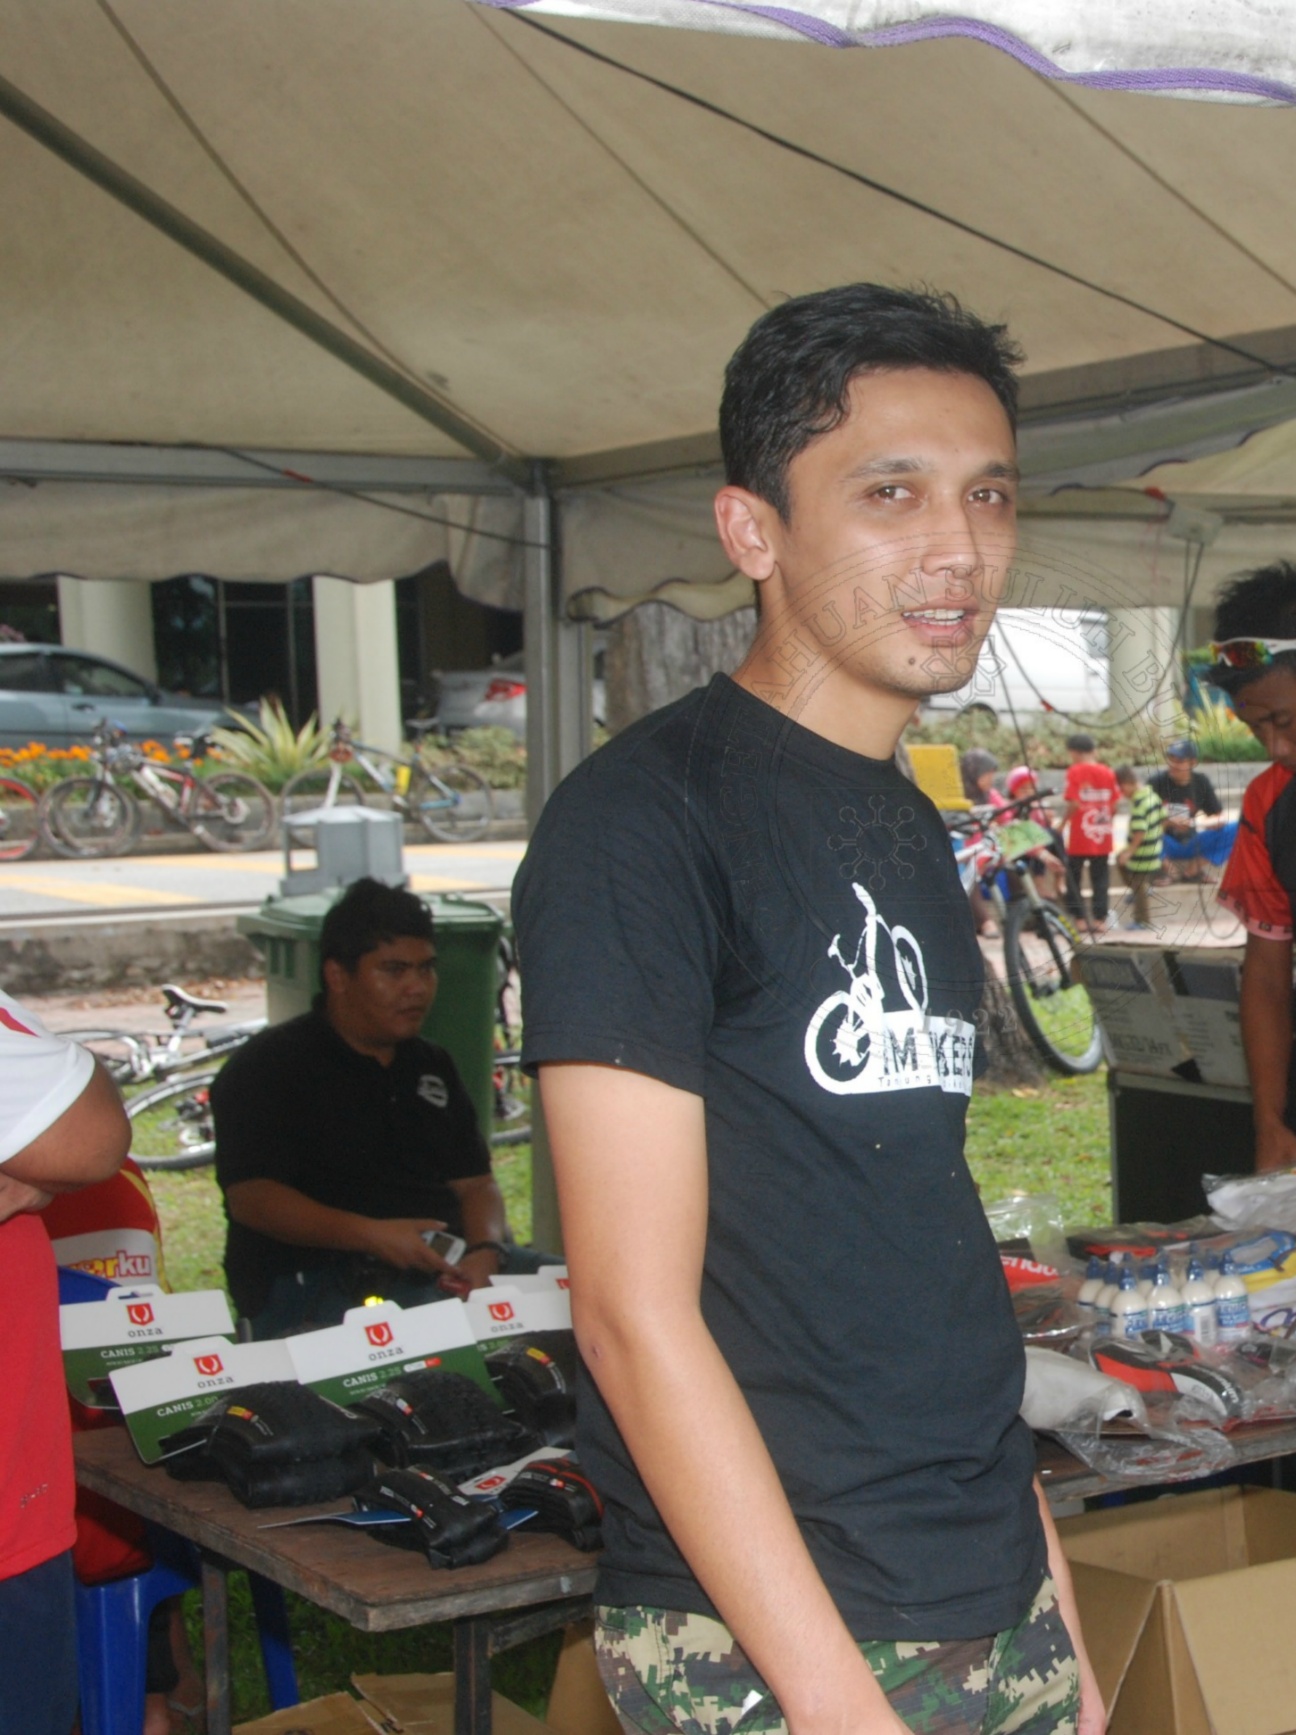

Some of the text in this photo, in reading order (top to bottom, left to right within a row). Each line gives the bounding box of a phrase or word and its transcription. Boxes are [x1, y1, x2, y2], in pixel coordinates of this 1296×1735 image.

[128, 1326, 163, 1338] onza
[101, 1347, 135, 1359] CANIS
[368, 1346, 404, 1362] onza
[197, 1374, 235, 1389] onza
[343, 1372, 379, 1388] CANIS
[157, 1401, 194, 1417] CANIS
